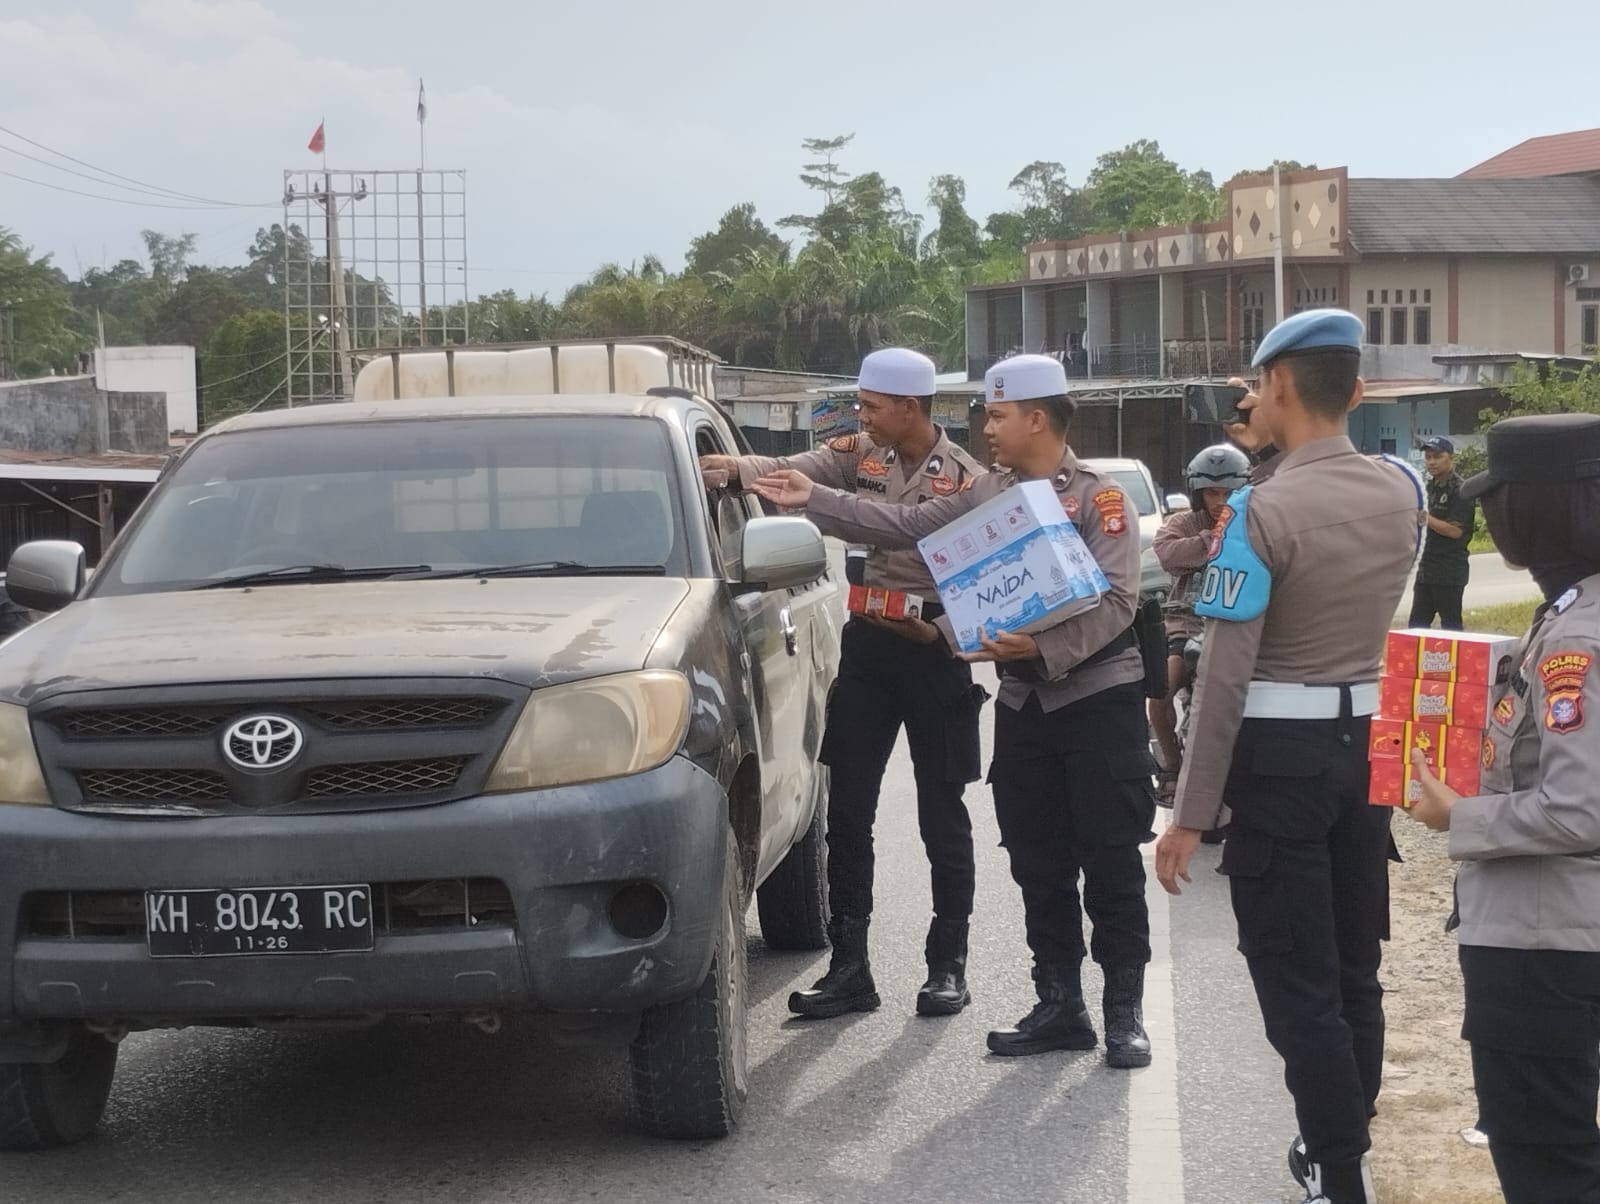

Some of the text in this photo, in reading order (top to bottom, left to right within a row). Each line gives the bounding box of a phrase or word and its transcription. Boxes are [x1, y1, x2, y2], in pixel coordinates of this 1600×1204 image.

[1542, 655, 1589, 675] POLRES
[150, 890, 367, 933] KH 8043 RC
